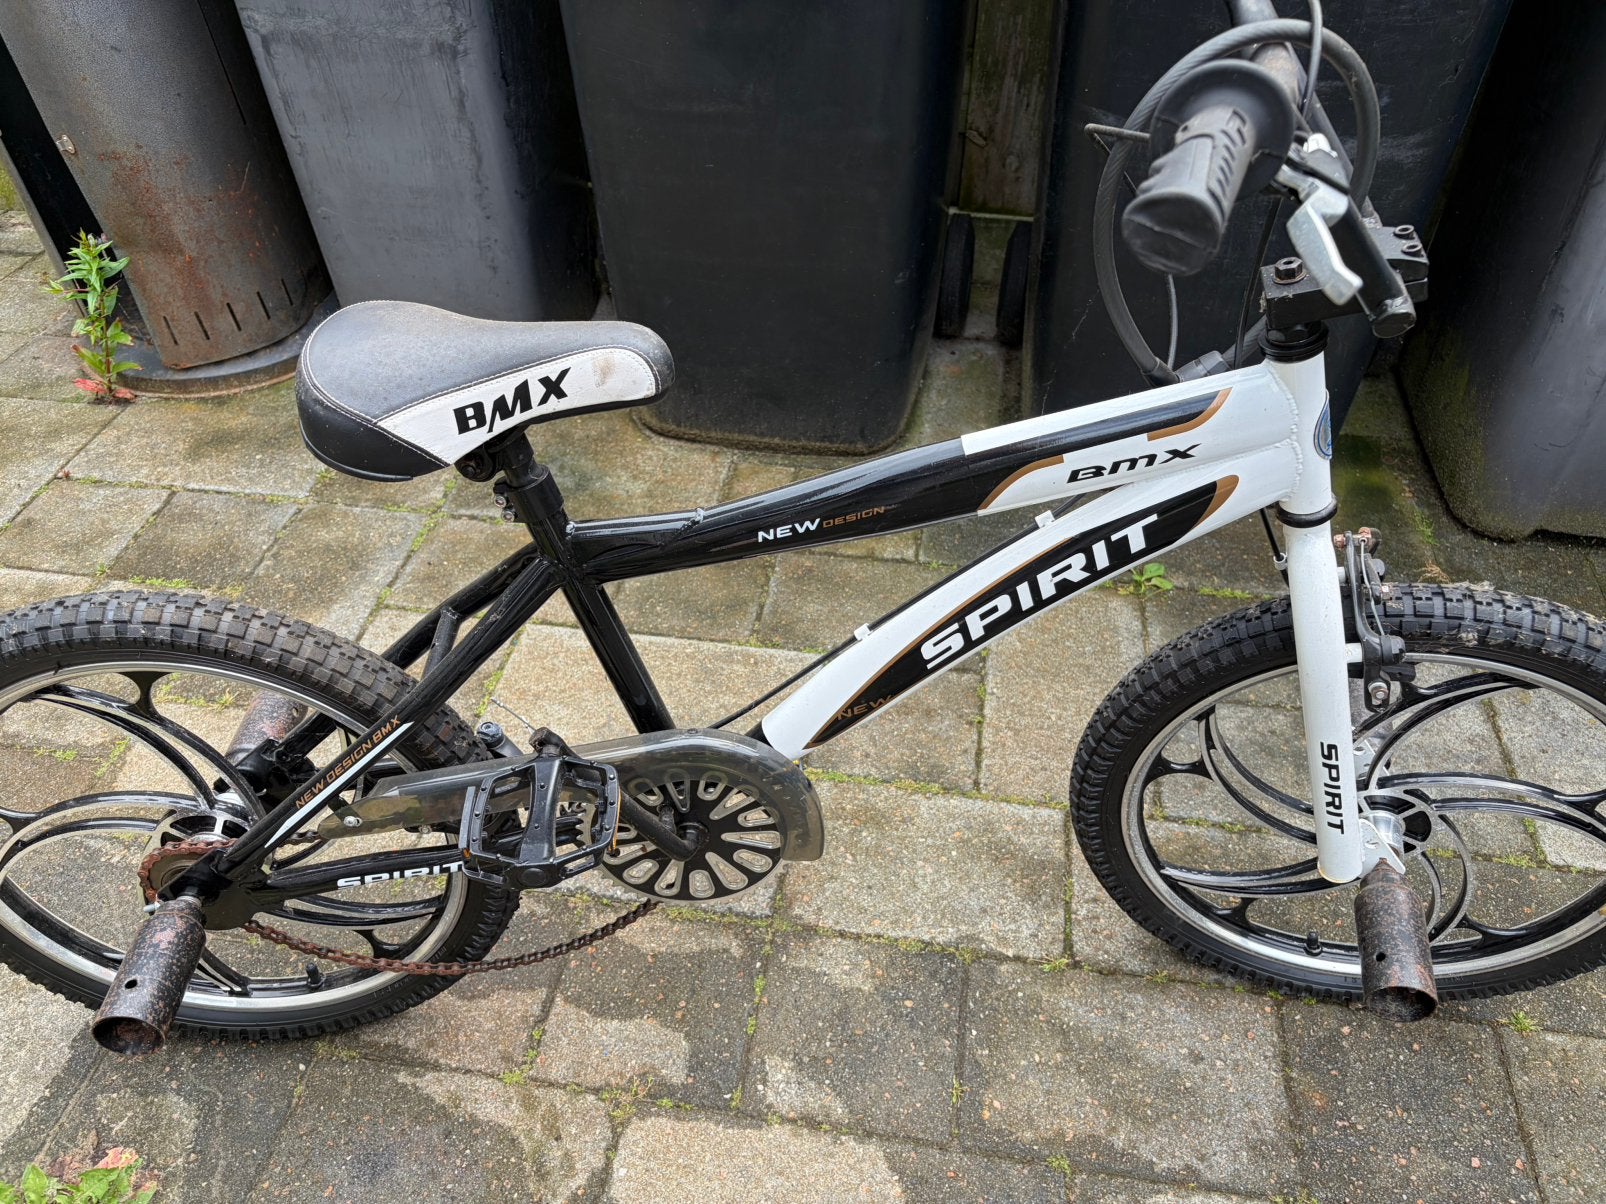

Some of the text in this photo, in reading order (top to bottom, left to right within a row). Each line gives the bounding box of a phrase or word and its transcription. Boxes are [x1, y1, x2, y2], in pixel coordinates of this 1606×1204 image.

[453, 367, 571, 435] BMX
[1066, 443, 1202, 483] BMX
[757, 505, 886, 543] NEW DESIGN
[920, 513, 1158, 670] SPIRIT
[837, 694, 894, 721] NEW
[295, 714, 401, 809] NEW DESIGN BMX
[1320, 741, 1345, 835] SPIRIT
